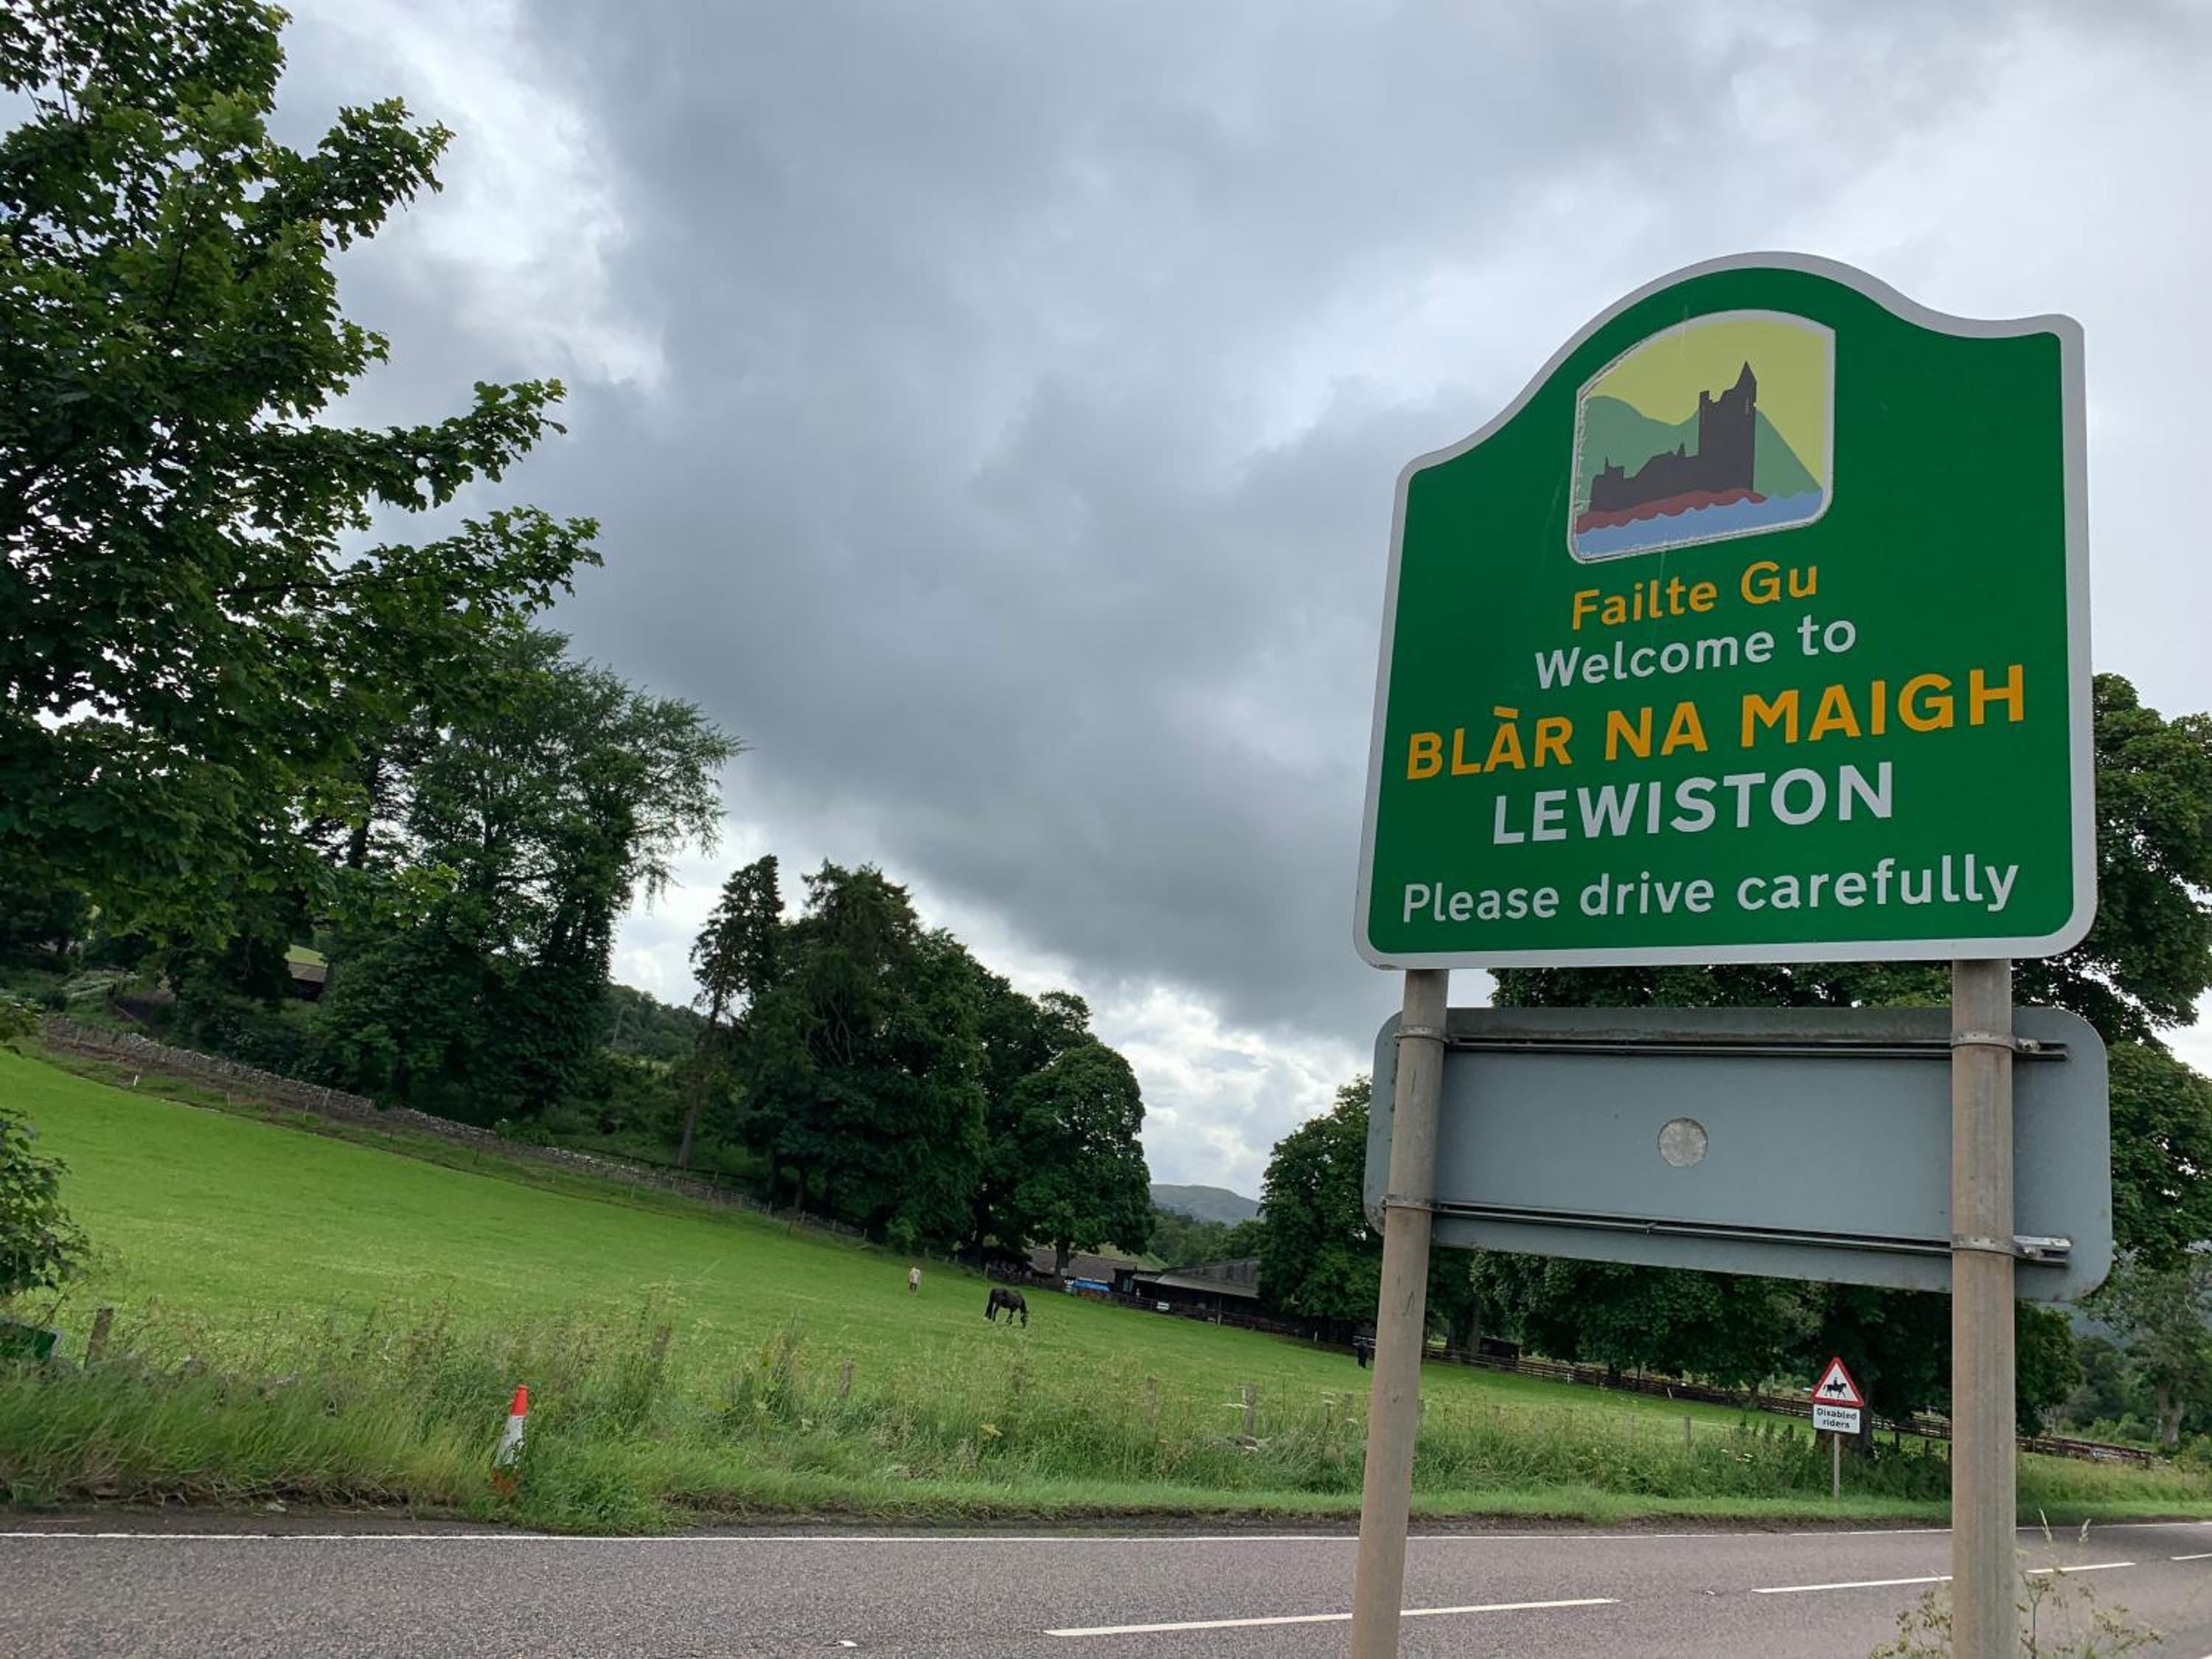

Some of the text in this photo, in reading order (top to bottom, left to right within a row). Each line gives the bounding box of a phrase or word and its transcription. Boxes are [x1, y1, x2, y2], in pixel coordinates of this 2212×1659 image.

[1572, 561, 1818, 630] Failte Gu
[1535, 614, 1857, 689] Welcome to
[1407, 664, 2025, 779] BLÀR NA MAIGH
[1493, 762, 1893, 844] LEWISTON
[1403, 854, 2019, 922] Please drive carefully
[1817, 1408, 1857, 1420] Disabled
[1823, 1419, 1850, 1428] riders
